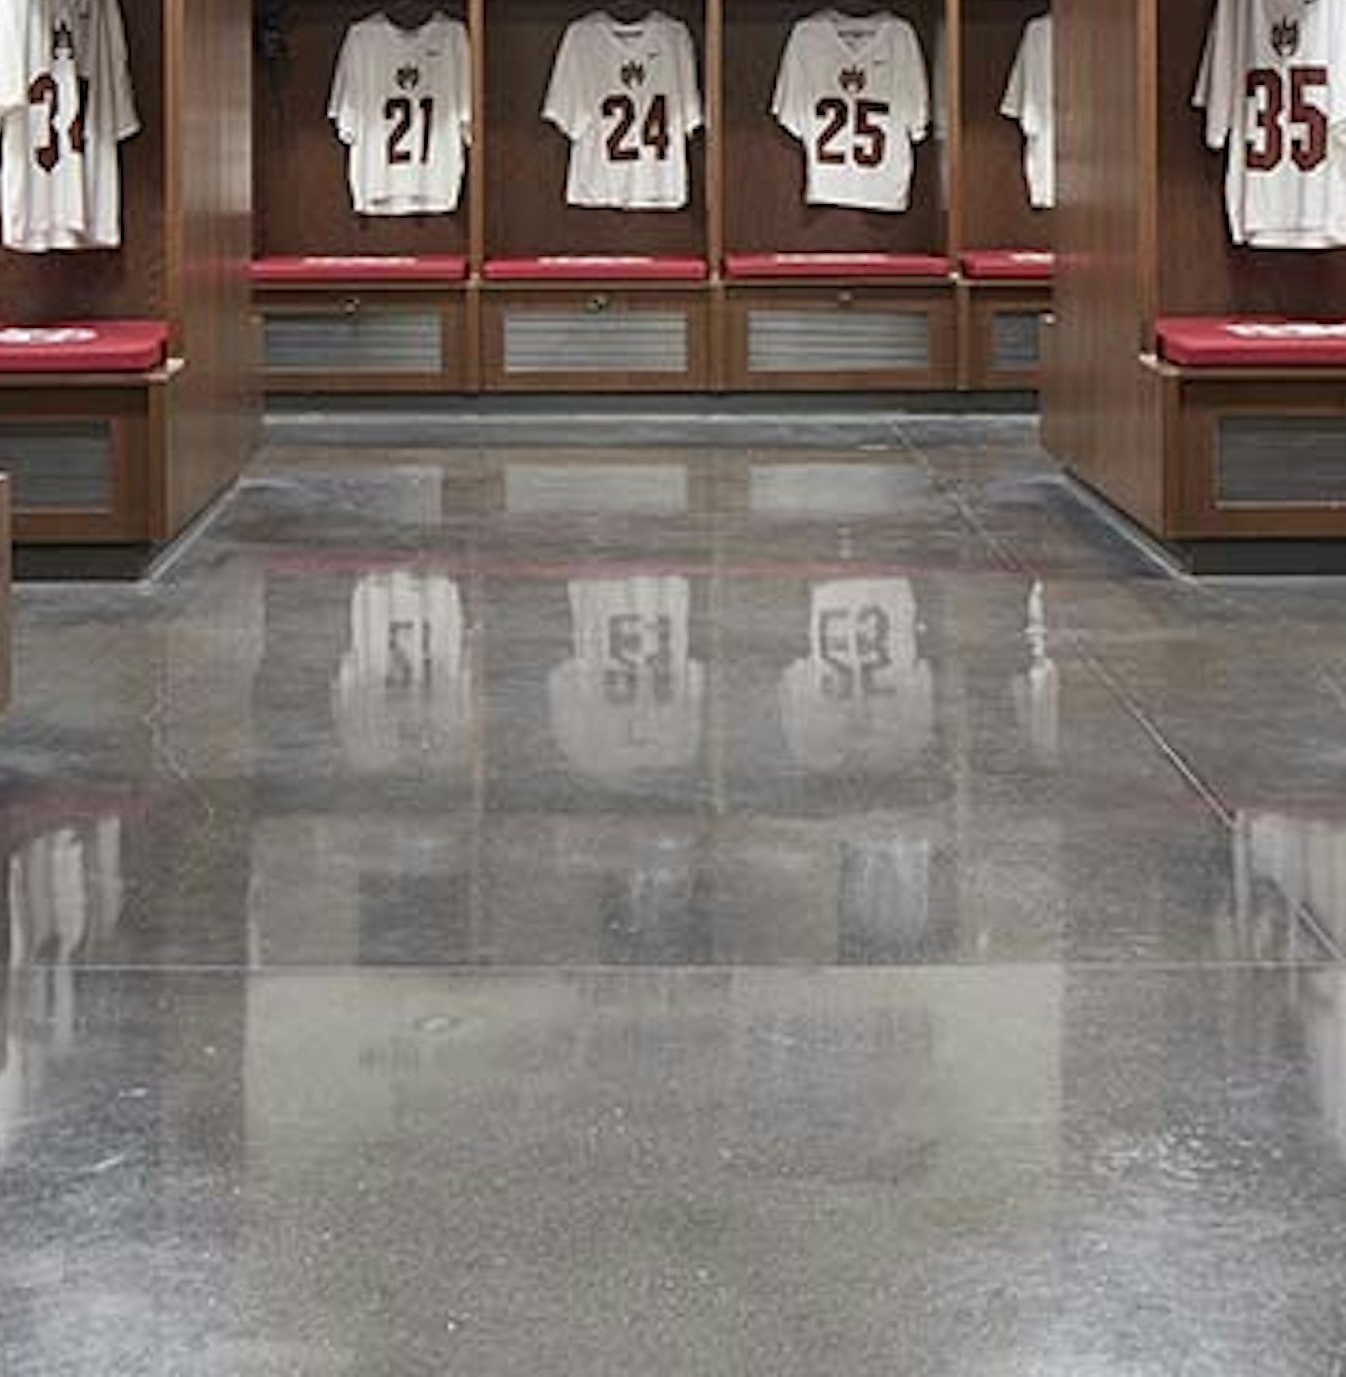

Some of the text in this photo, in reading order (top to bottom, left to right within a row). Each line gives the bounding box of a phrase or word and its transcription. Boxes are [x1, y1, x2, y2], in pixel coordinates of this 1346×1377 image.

[384, 97, 434, 165] 21
[600, 95, 670, 161] 24
[815, 97, 890, 167] 25
[1245, 68, 1328, 172] 35
